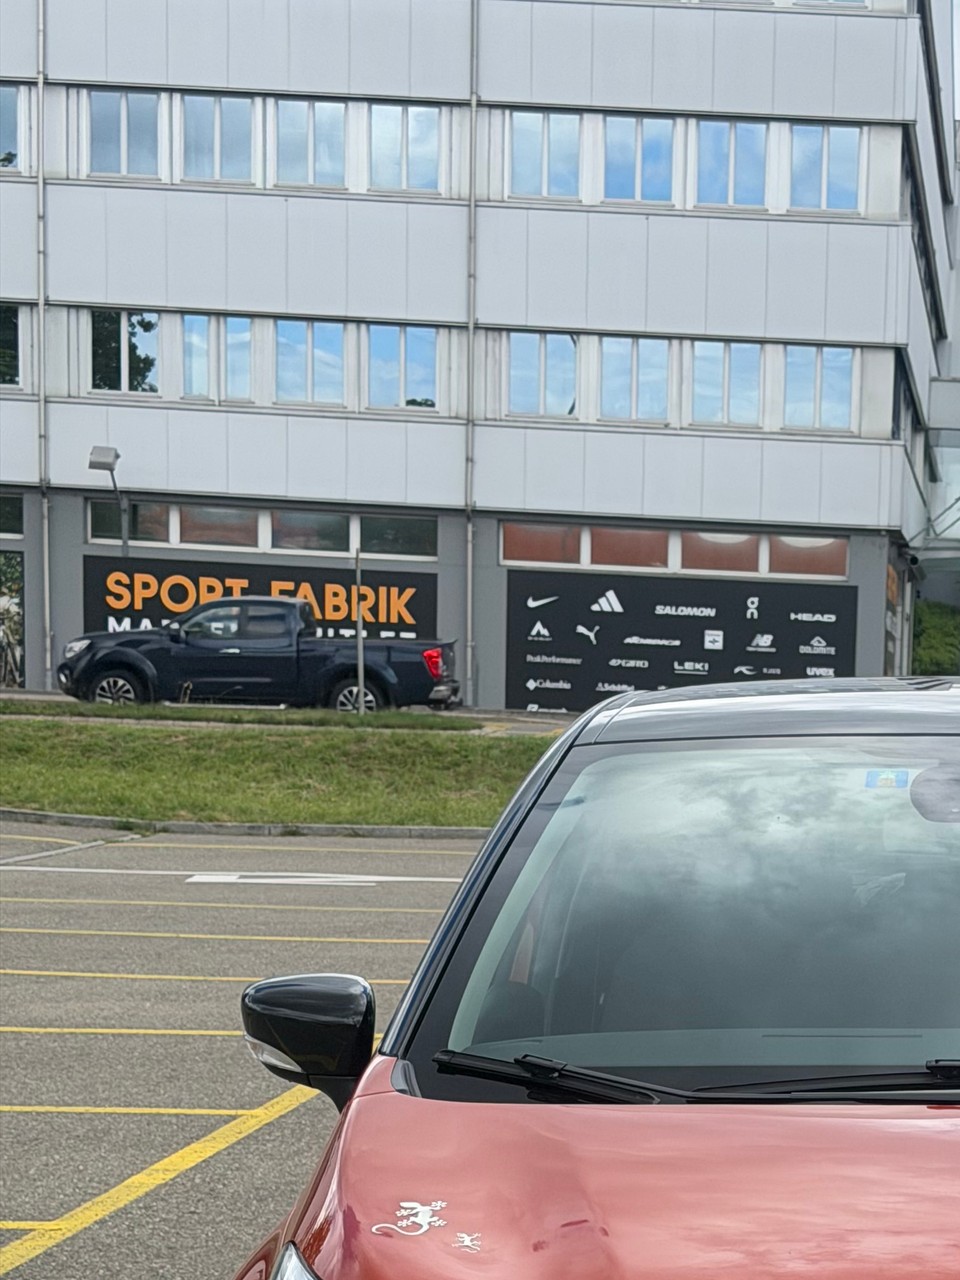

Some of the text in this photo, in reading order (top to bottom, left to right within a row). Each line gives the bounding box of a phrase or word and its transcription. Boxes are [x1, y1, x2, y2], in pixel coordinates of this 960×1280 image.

[654, 604, 716, 617] SALOMON
[790, 612, 836, 622] HEAD
[673, 661, 709, 671] LEKI
[806, 667, 835, 677] uvex
